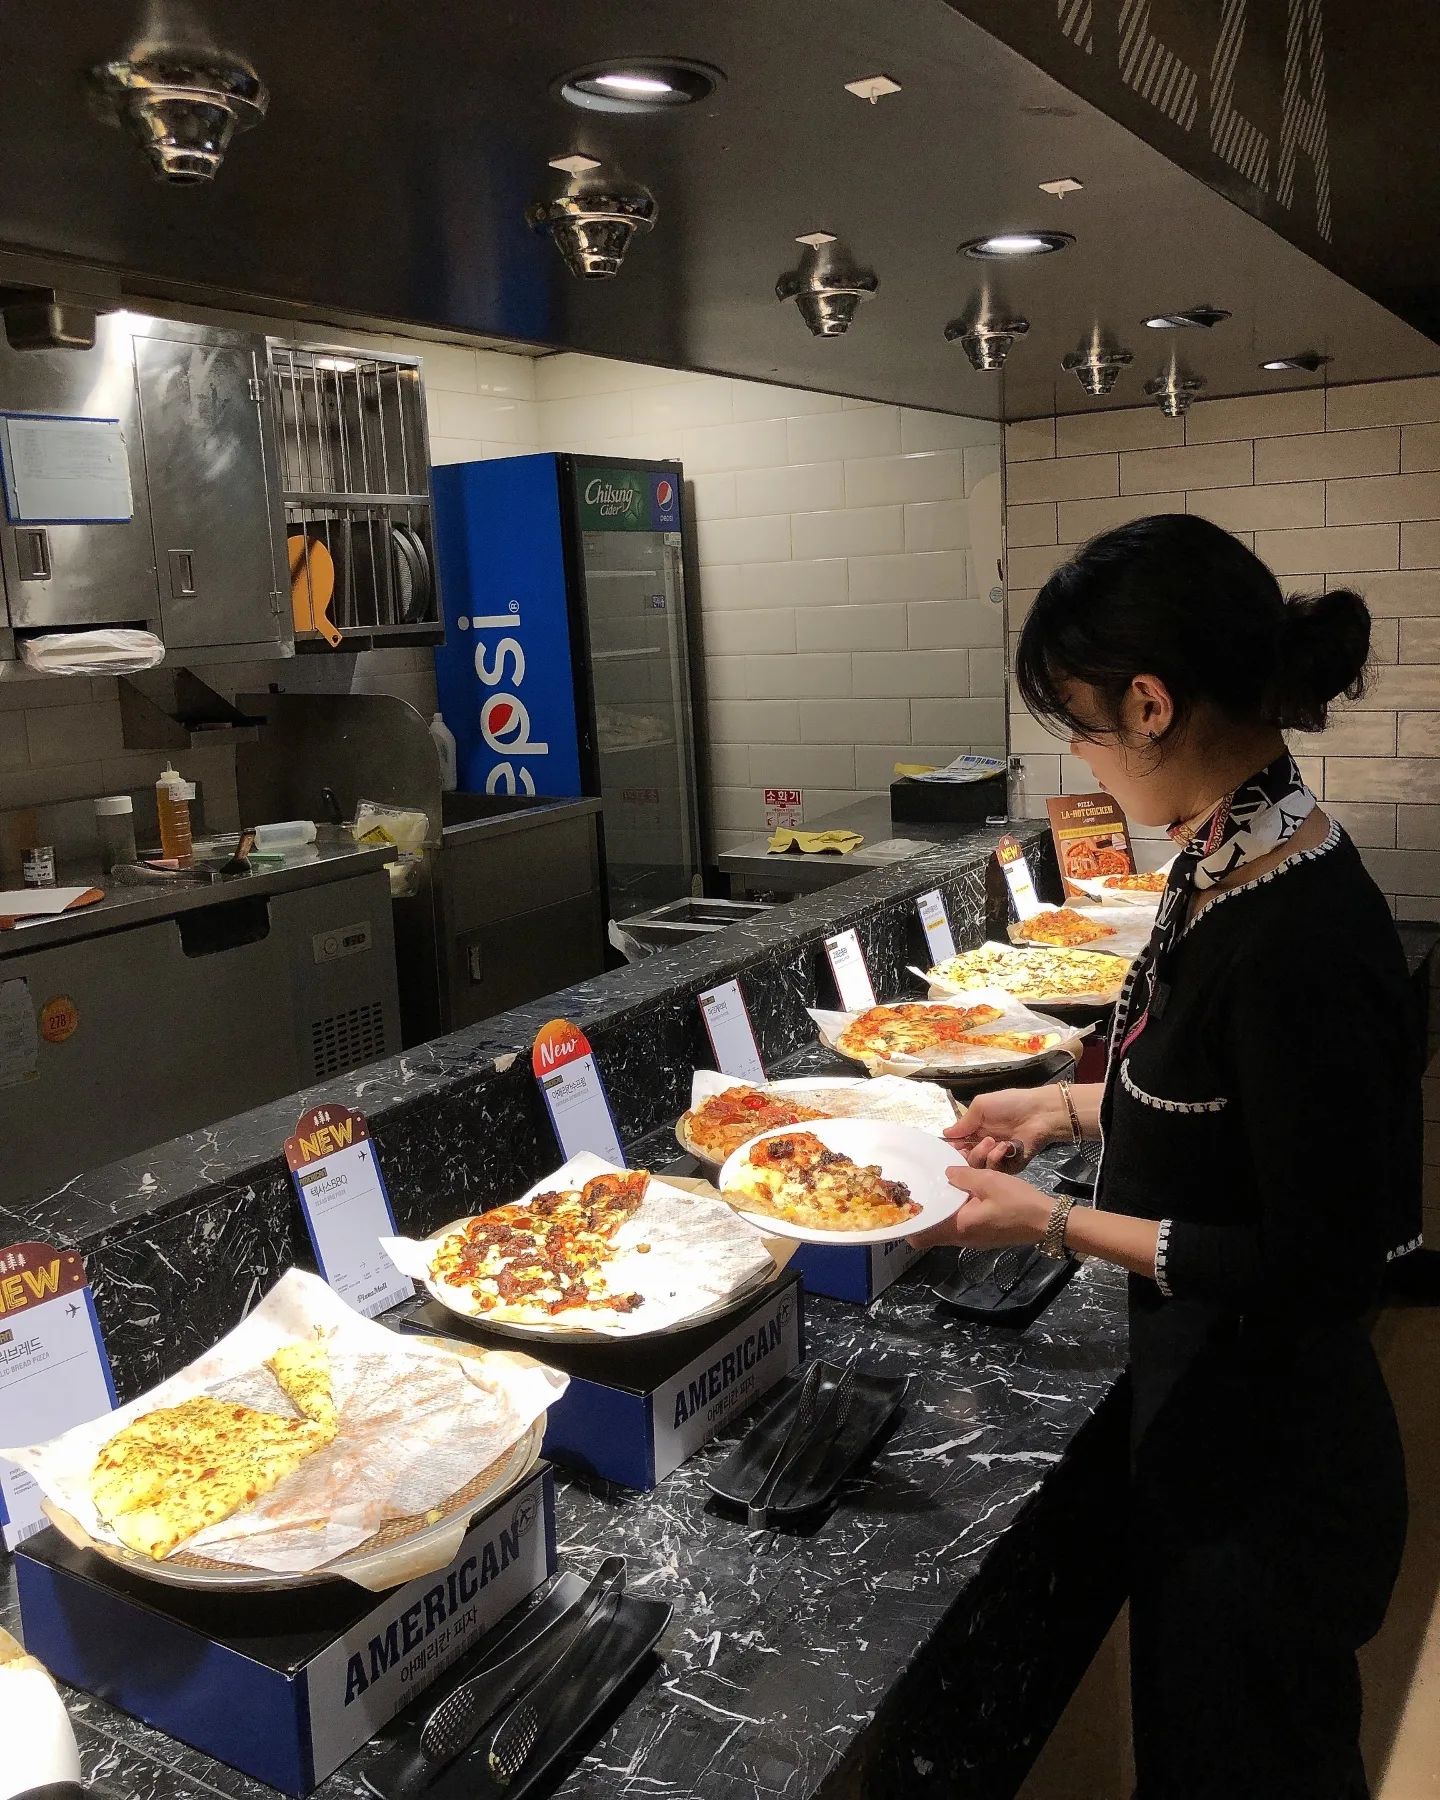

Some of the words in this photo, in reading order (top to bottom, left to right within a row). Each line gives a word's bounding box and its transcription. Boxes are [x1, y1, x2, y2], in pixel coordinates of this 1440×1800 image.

[600, 504, 621, 517] Cider
[766, 790, 799, 802] 소화기
[1001, 844, 1020, 863] NEW
[540, 1035, 578, 1068] New
[298, 1117, 353, 1162] NEW
[310, 1174, 348, 1197] 텍사스BBQ
[674, 1315, 782, 1430] AMERICAN
[344, 1520, 520, 1707] AMERICAN
[401, 1627, 451, 1683] 아메리칸
[453, 1605, 478, 1637] 피자
